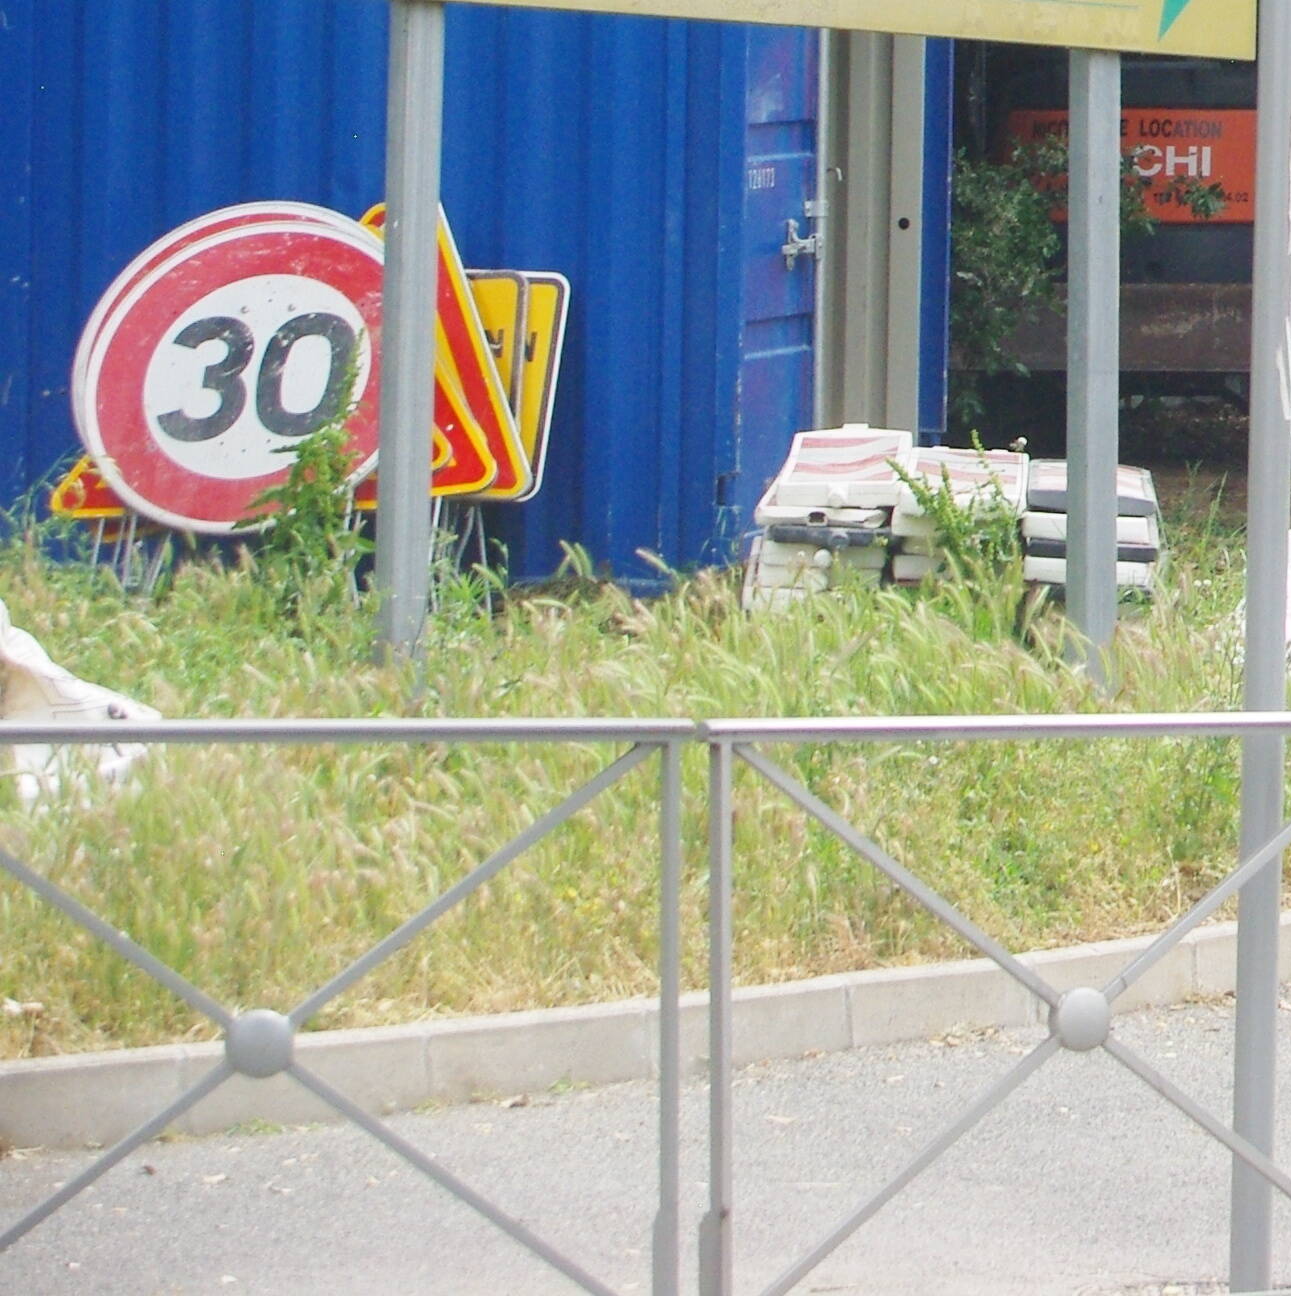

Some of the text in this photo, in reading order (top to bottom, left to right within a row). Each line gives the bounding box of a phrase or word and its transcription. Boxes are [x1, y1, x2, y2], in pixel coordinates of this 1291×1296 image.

[1139, 119, 1222, 138] LOCATION
[1133, 145, 1212, 177] CHI
[157, 311, 359, 442] 30
